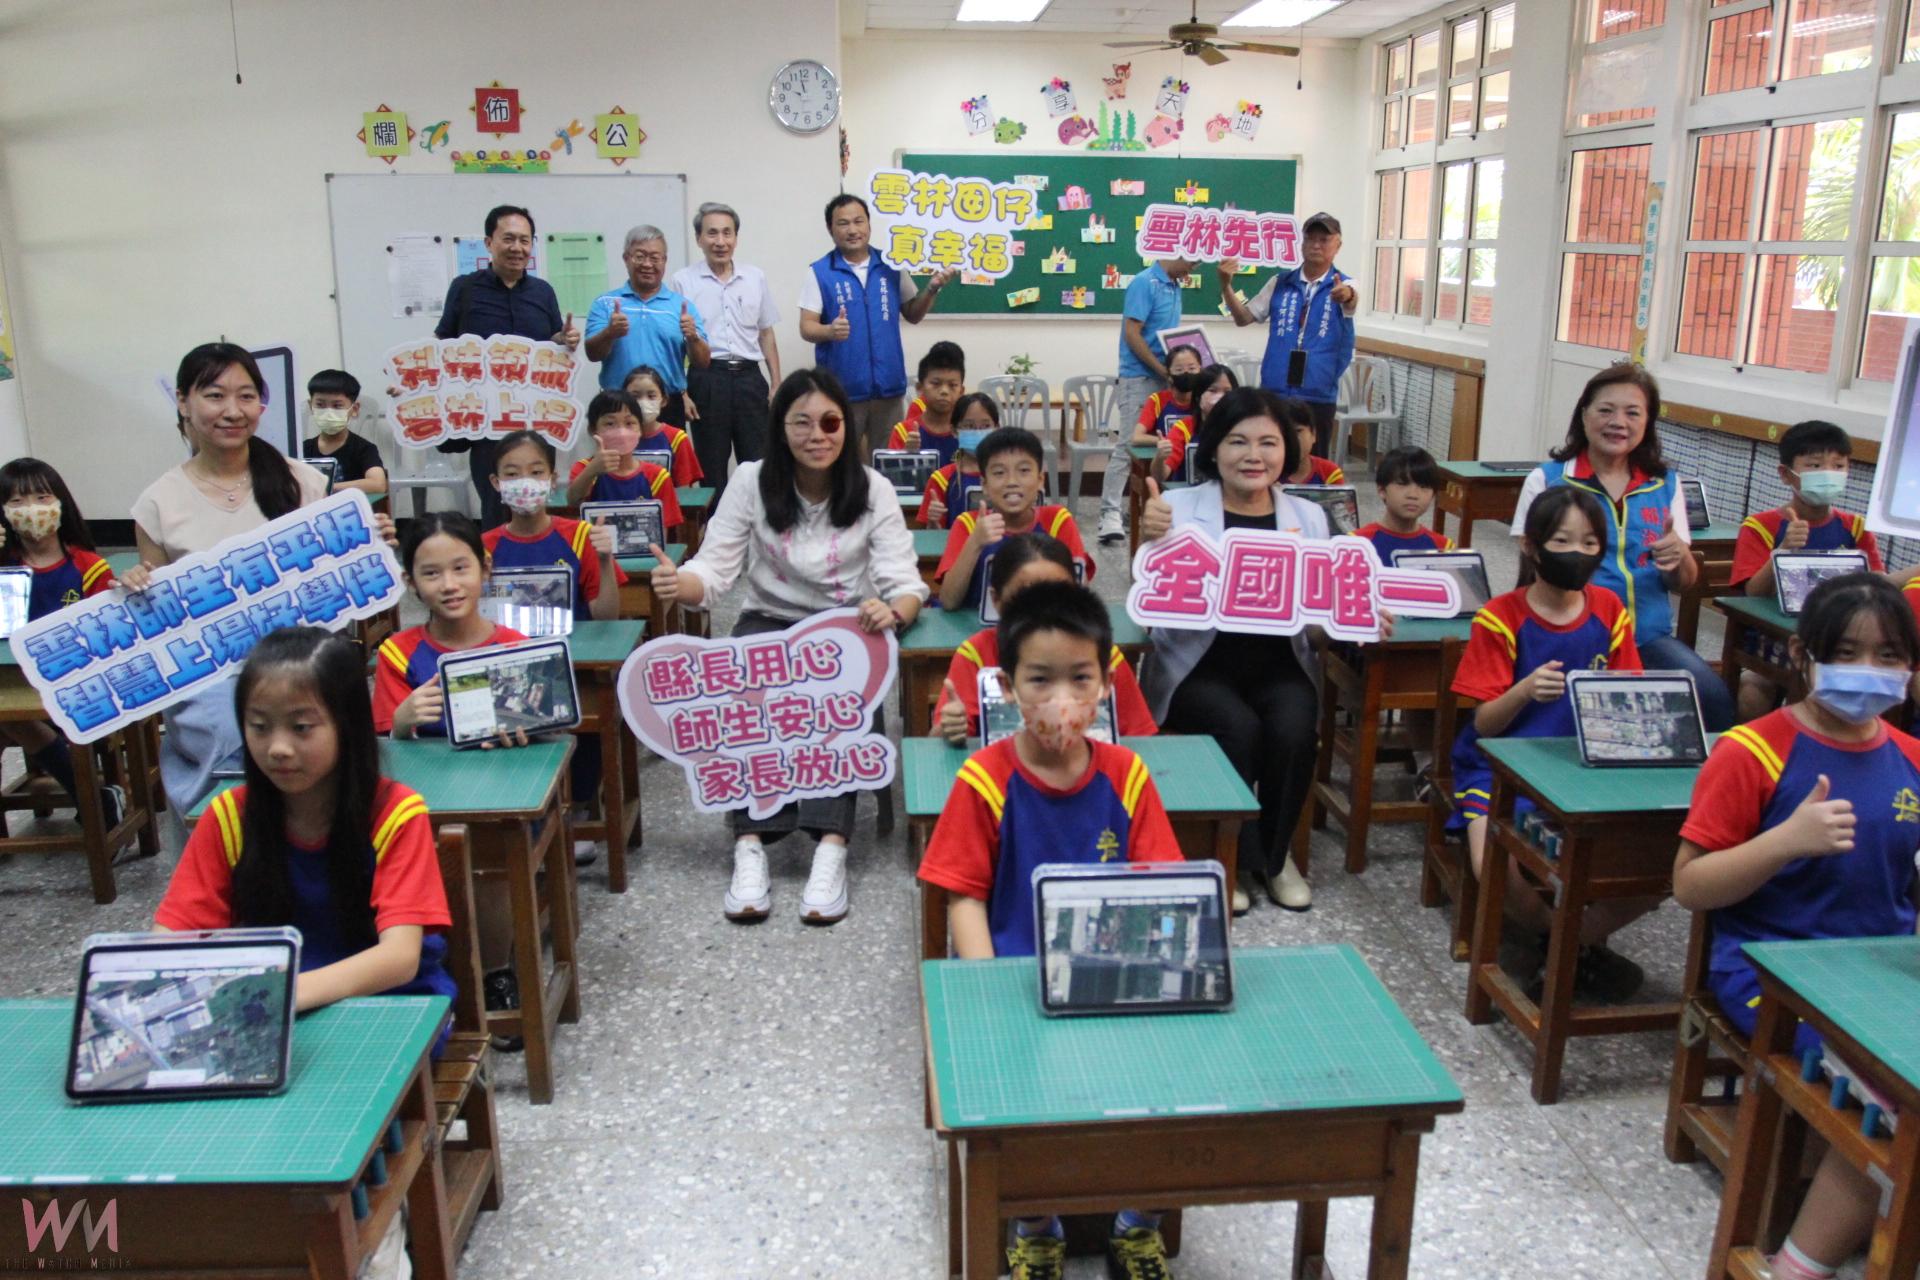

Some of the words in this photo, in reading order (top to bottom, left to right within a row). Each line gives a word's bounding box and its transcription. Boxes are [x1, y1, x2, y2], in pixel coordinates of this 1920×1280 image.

[790, 73, 797, 81] 11
[799, 69, 809, 78] 12
[781, 82, 792, 91] 10
[822, 80, 828, 89] 2
[779, 93, 786, 103] 9
[826, 91, 832, 100] 3
[1163, 92, 1181, 110] 天
[485, 97, 510, 122] 佈
[784, 105, 791, 114] 8
[793, 112, 799, 121] 7
[816, 111, 823, 120] 5
[823, 103, 829, 112] 4
[804, 115, 811, 124] 6
[972, 111, 987, 129] 分
[1235, 115, 1252, 134] 地
[373, 122, 398, 147] 欄
[606, 122, 629, 148] 公
[1143, 210, 1297, 262] 雲林先行
[887, 225, 1009, 273] 真幸福
[396, 392, 576, 442] 雲林上場
[24, 500, 371, 682] 雲林師生有平板
[1138, 536, 1450, 628] 全國唯一
[55, 553, 396, 733] 智慧上場好學伴
[645, 640, 841, 702] 縣長用心
[671, 692, 863, 754] 師生安心
[697, 744, 887, 803] 家長放心
